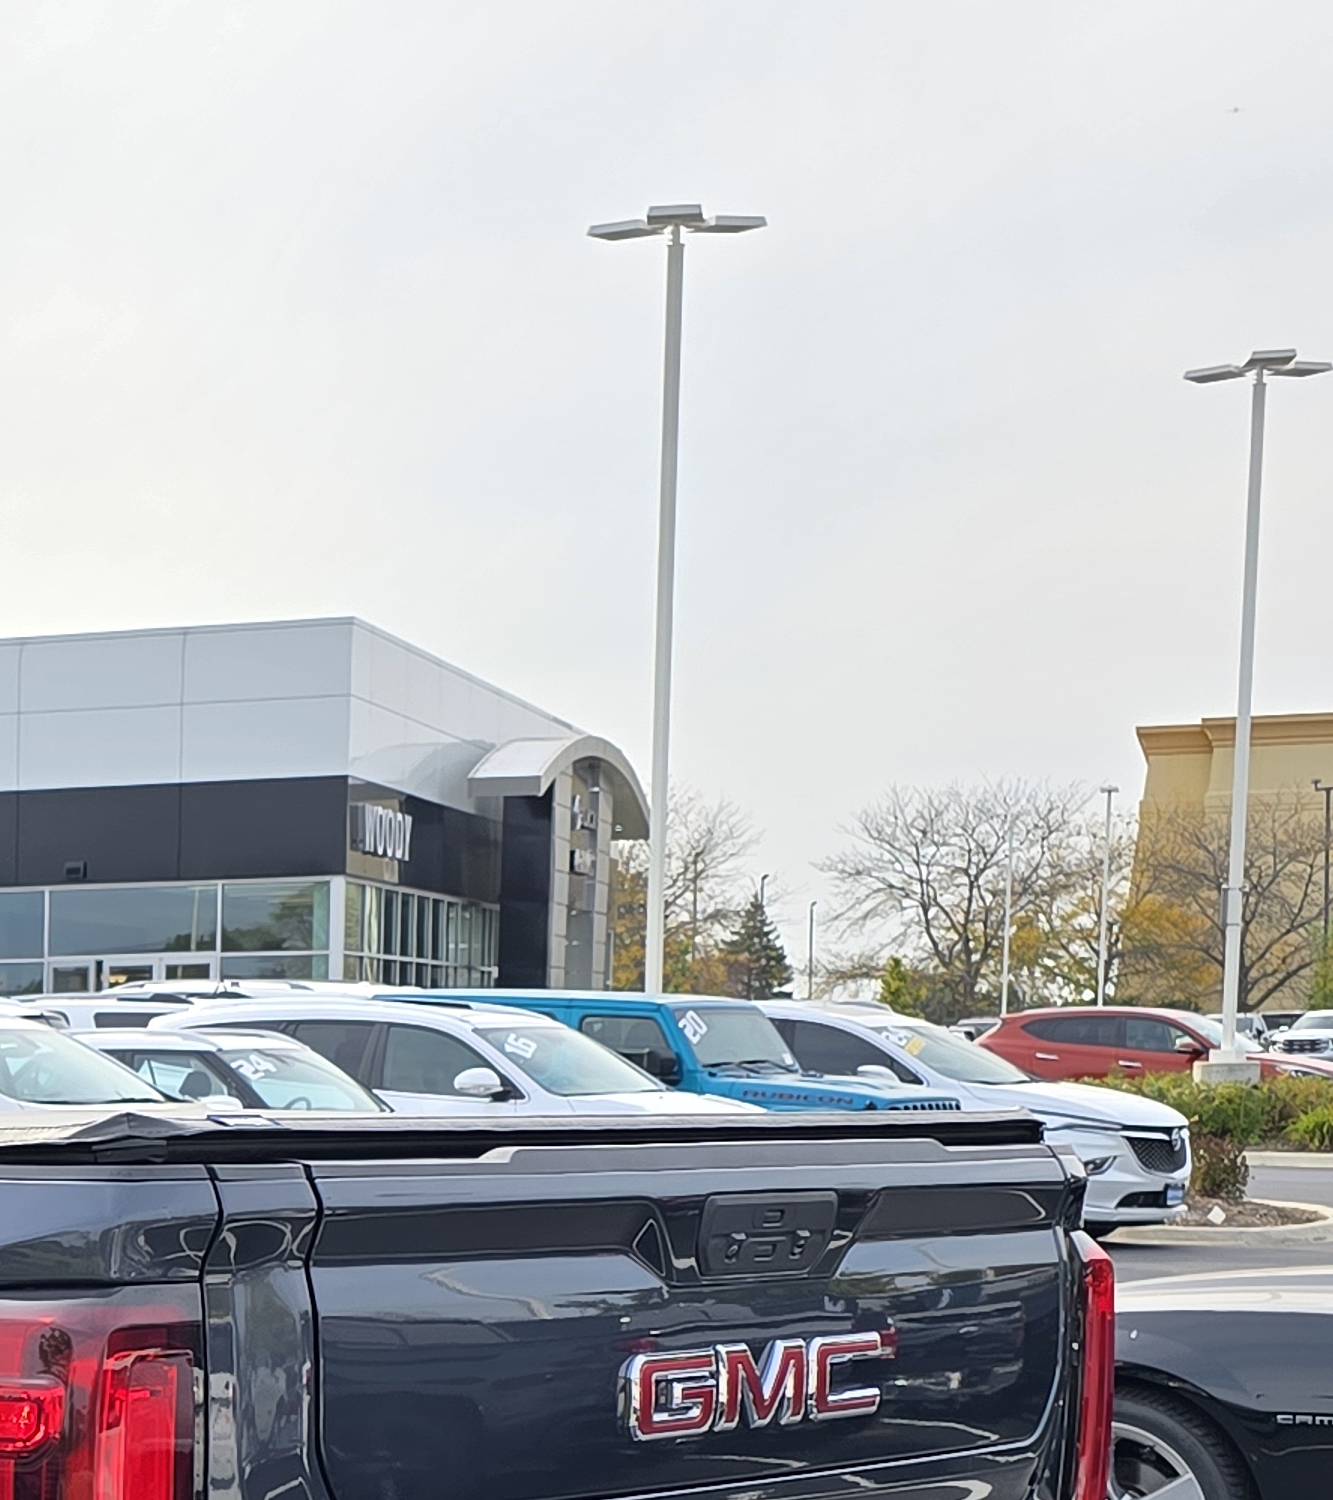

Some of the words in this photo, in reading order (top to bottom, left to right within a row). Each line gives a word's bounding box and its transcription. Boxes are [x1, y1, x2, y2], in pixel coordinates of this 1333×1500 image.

[364, 801, 413, 862] WOODY
[678, 1010, 708, 1044] 20
[504, 1033, 537, 1059] 16
[231, 1055, 277, 1080] 24
[742, 1089, 854, 1105] RUBICON
[619, 1331, 881, 1441] GMC
